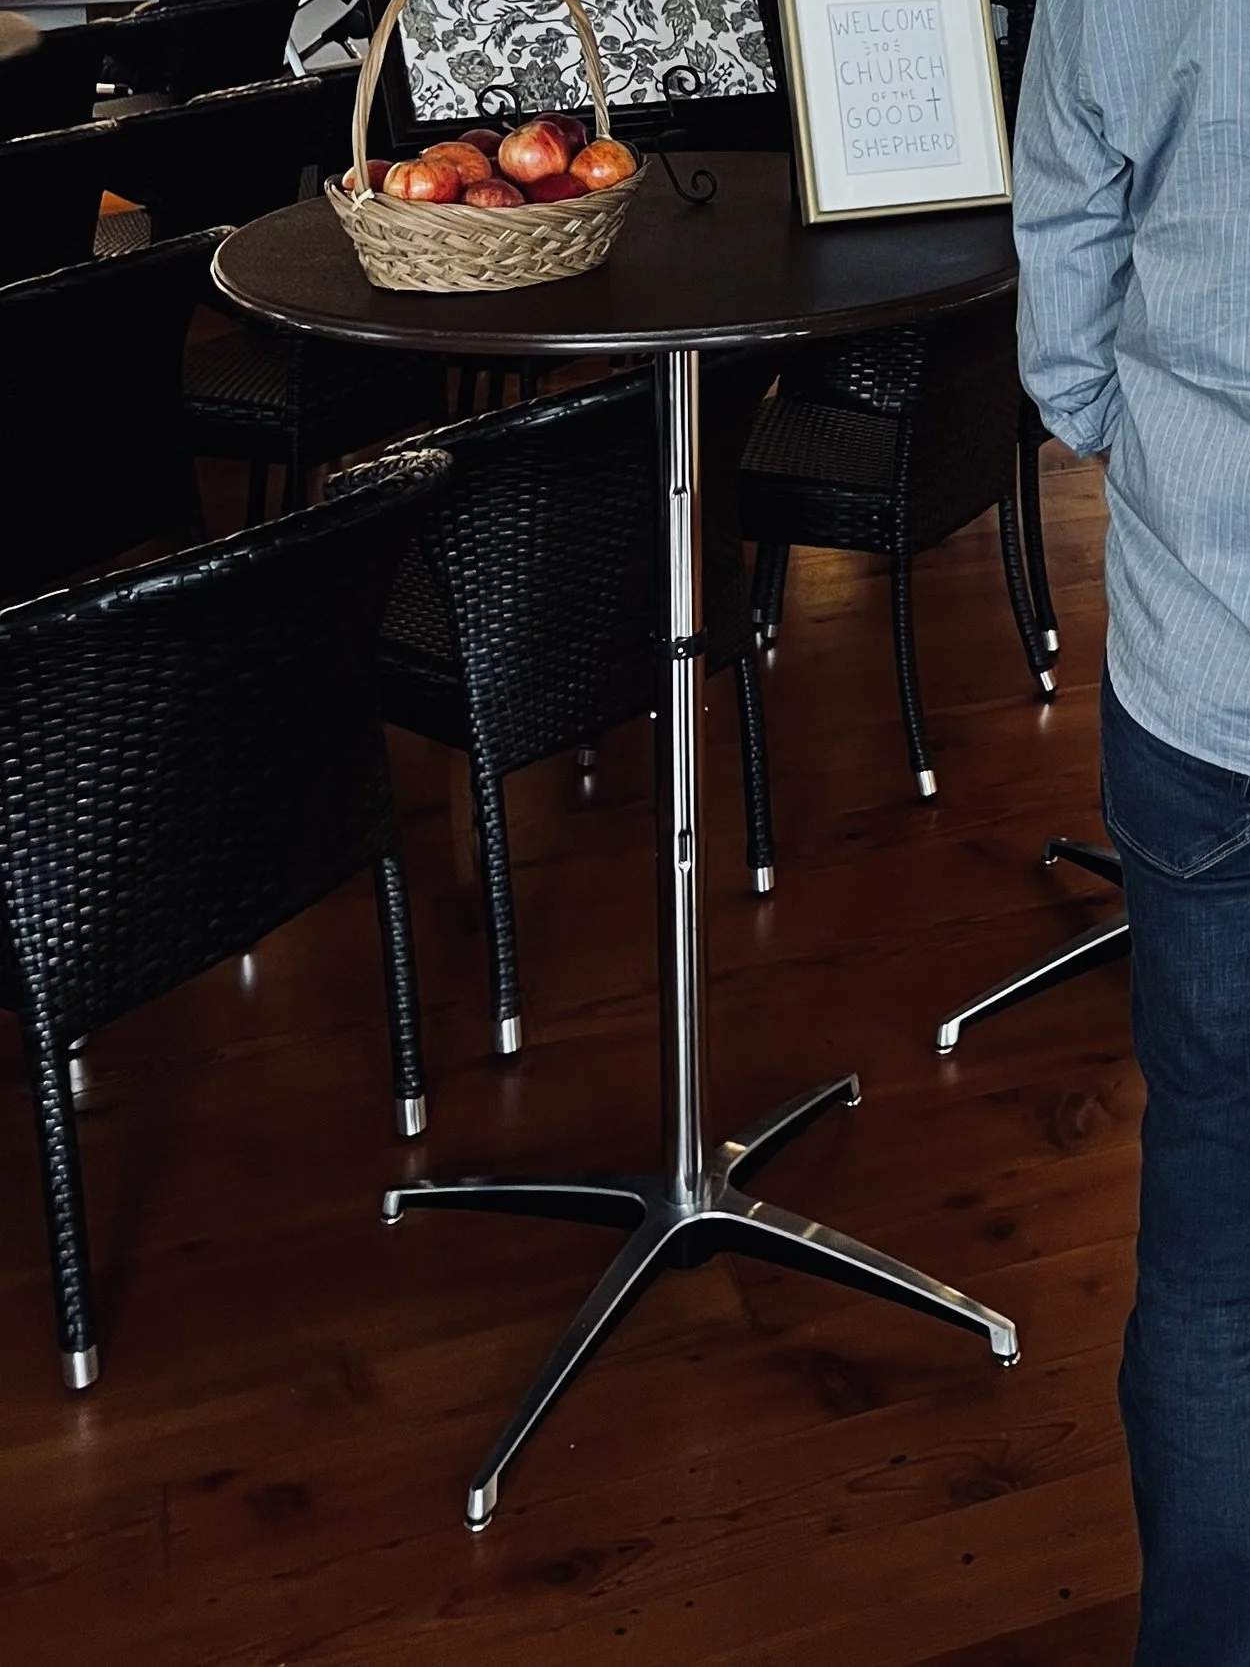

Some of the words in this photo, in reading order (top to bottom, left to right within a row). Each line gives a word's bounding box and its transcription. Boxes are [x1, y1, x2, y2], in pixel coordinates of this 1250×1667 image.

[832, 8, 937, 36] WELCOME
[873, 42, 889, 53] TO
[840, 55, 945, 85] CHURCH
[872, 91, 887, 103] OF
[892, 89, 916, 101] THE
[847, 104, 923, 129] GOOD
[852, 133, 955, 159] SHEPHERD
